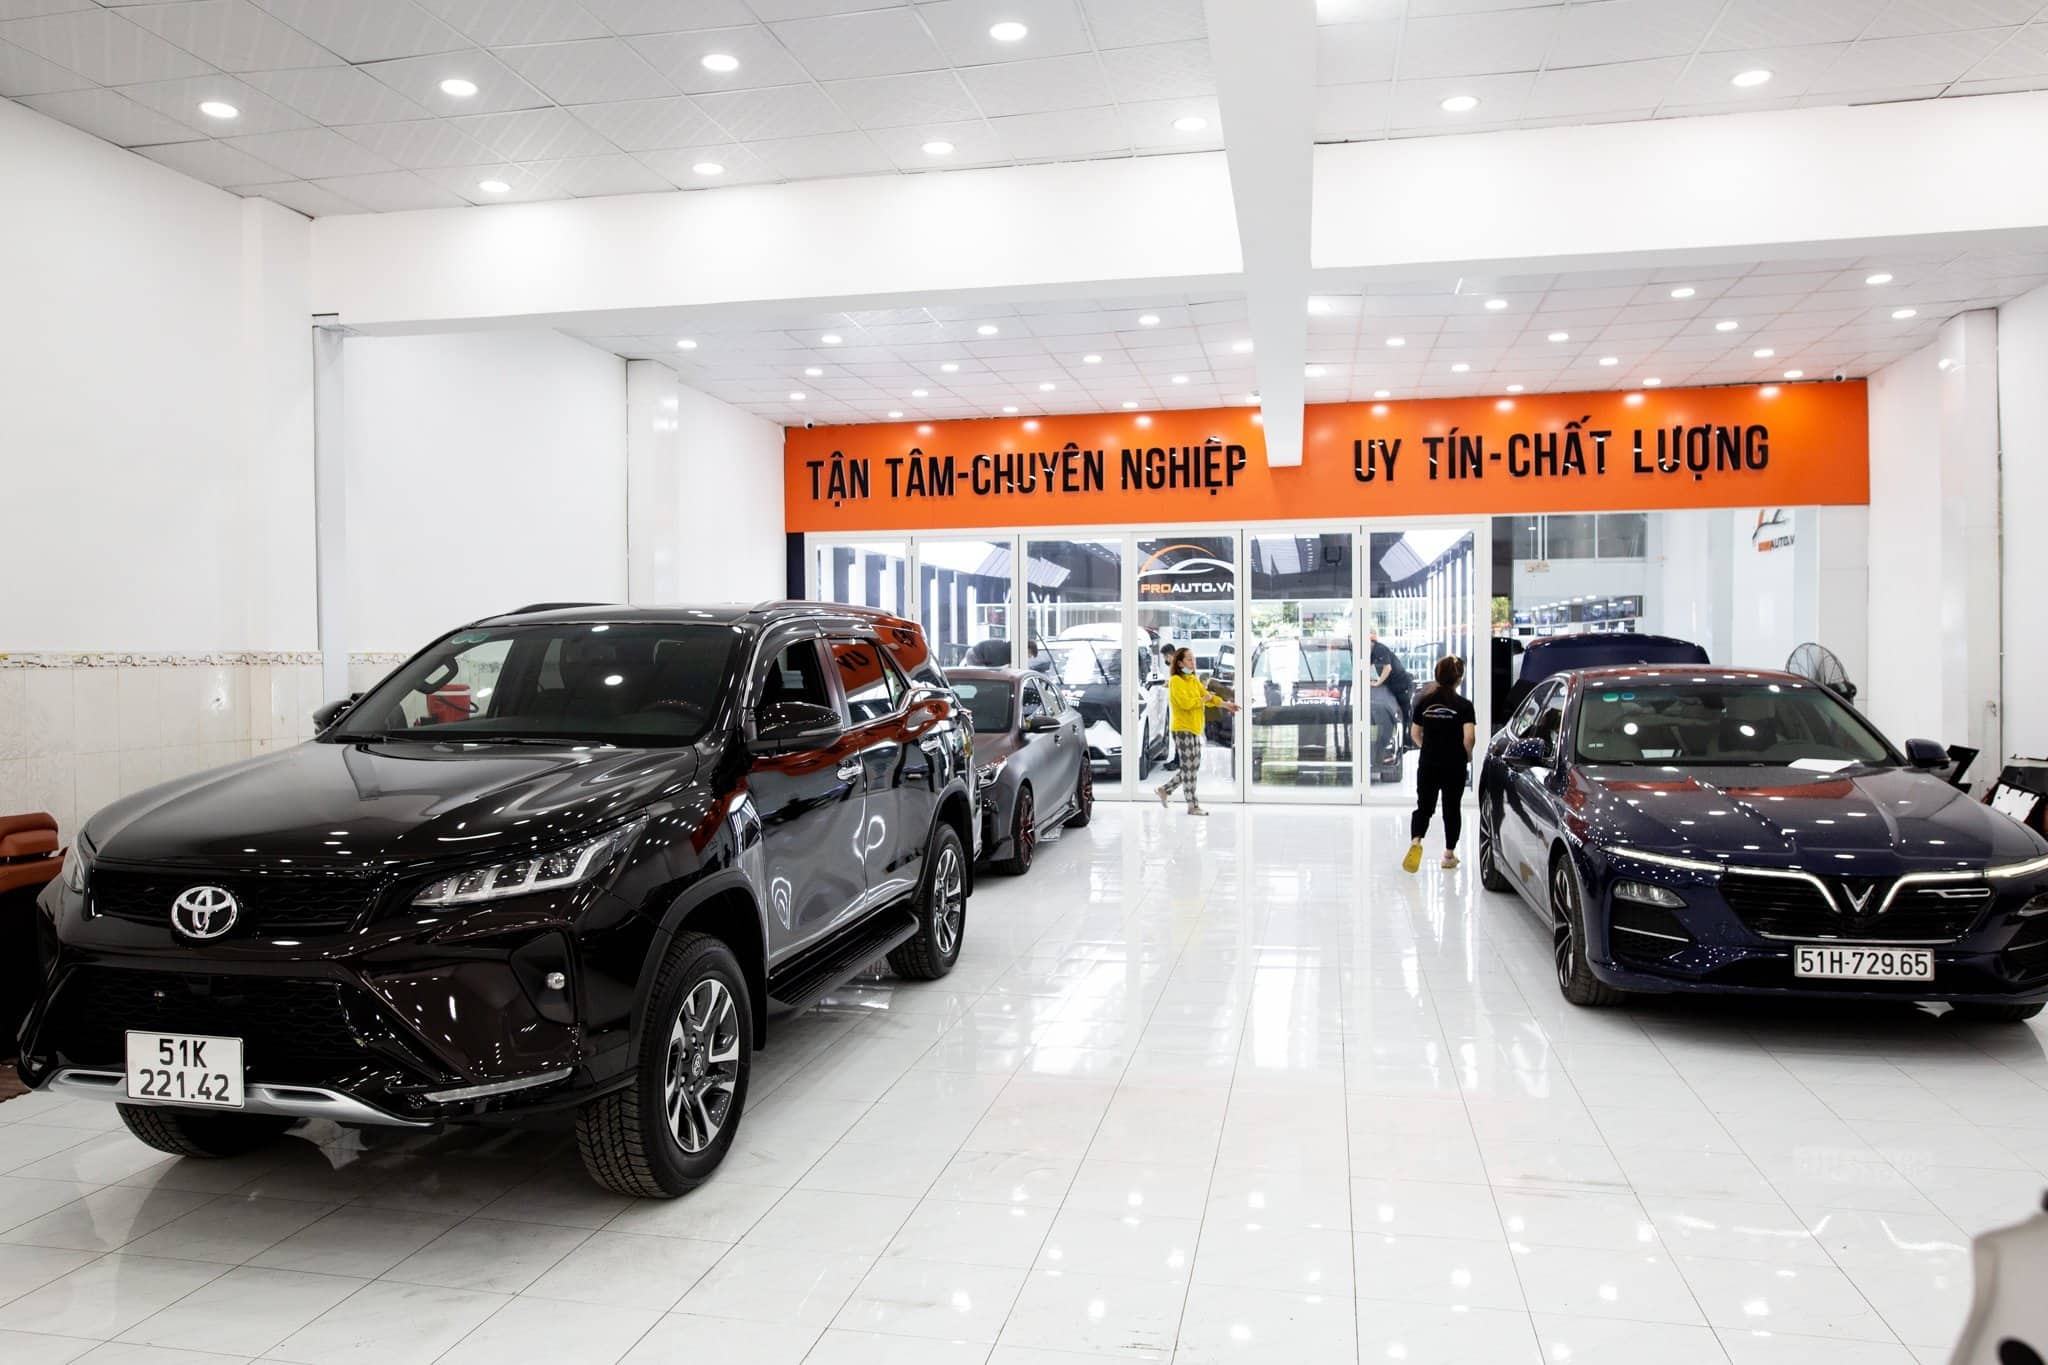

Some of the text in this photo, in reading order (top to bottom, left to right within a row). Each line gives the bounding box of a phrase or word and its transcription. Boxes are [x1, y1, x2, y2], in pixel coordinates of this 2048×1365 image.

[1354, 416, 1769, 482] UY TÍN-CHẤT LƯỢNG
[806, 436, 1247, 507] TẬN TÂM-CHUYÊN NGHIỆP
[1801, 951, 1928, 976] 51H-729.65
[159, 1038, 207, 1068] 51K
[140, 1068, 230, 1102] 221.42
